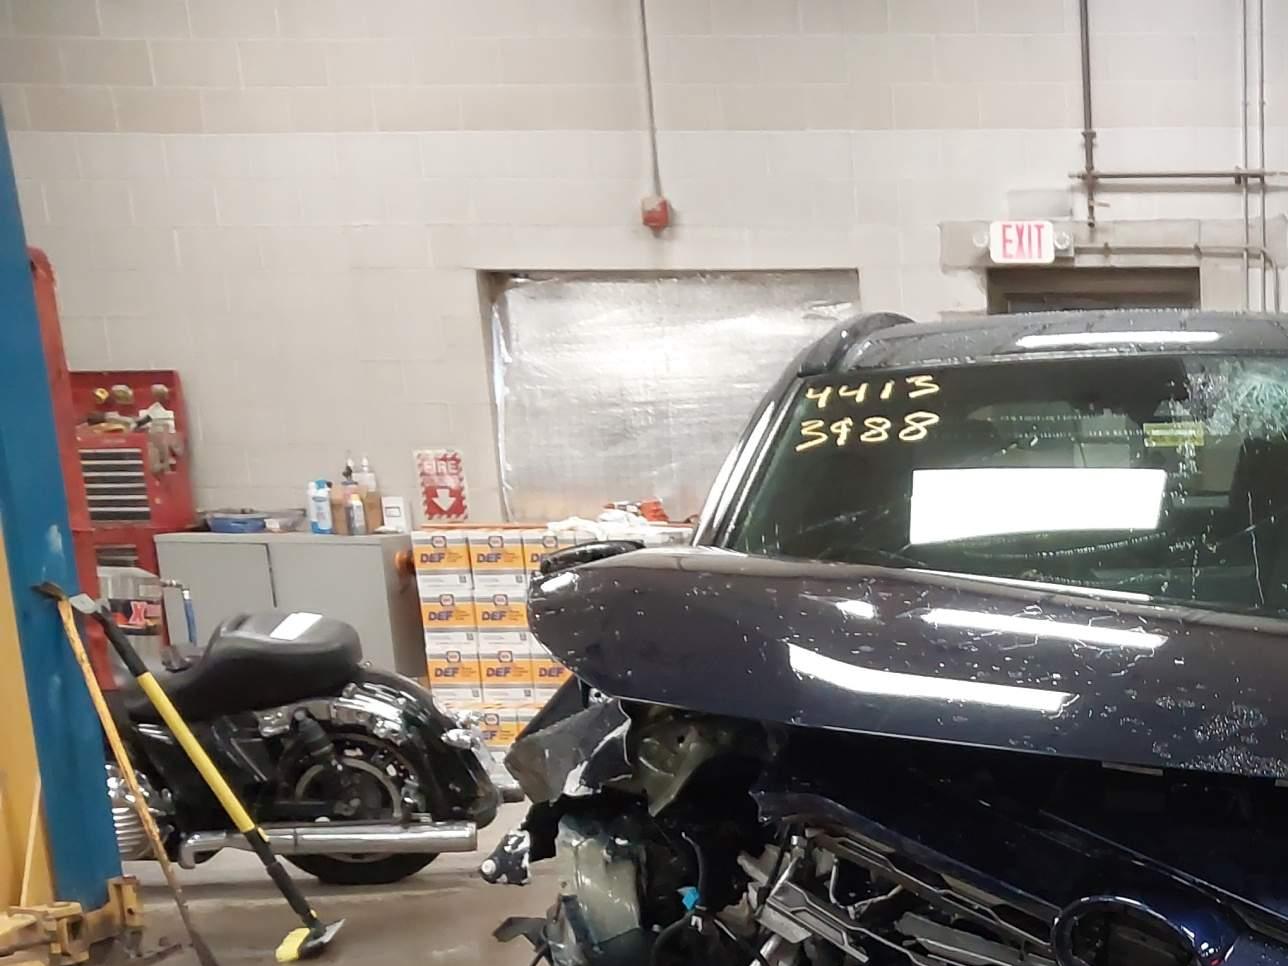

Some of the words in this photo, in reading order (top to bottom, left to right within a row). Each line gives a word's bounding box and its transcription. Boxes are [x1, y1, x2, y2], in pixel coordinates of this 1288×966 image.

[1002, 223, 1045, 259] EXIT
[806, 375, 940, 408] 4413
[423, 460, 460, 475] FIRE
[420, 553, 446, 563] DEF
[476, 553, 502, 563] DEF
[428, 611, 454, 621] DEF
[481, 611, 507, 621] DEF
[434, 667, 460, 677] DEF
[486, 667, 511, 677] DEF
[538, 667, 564, 677] DEF
